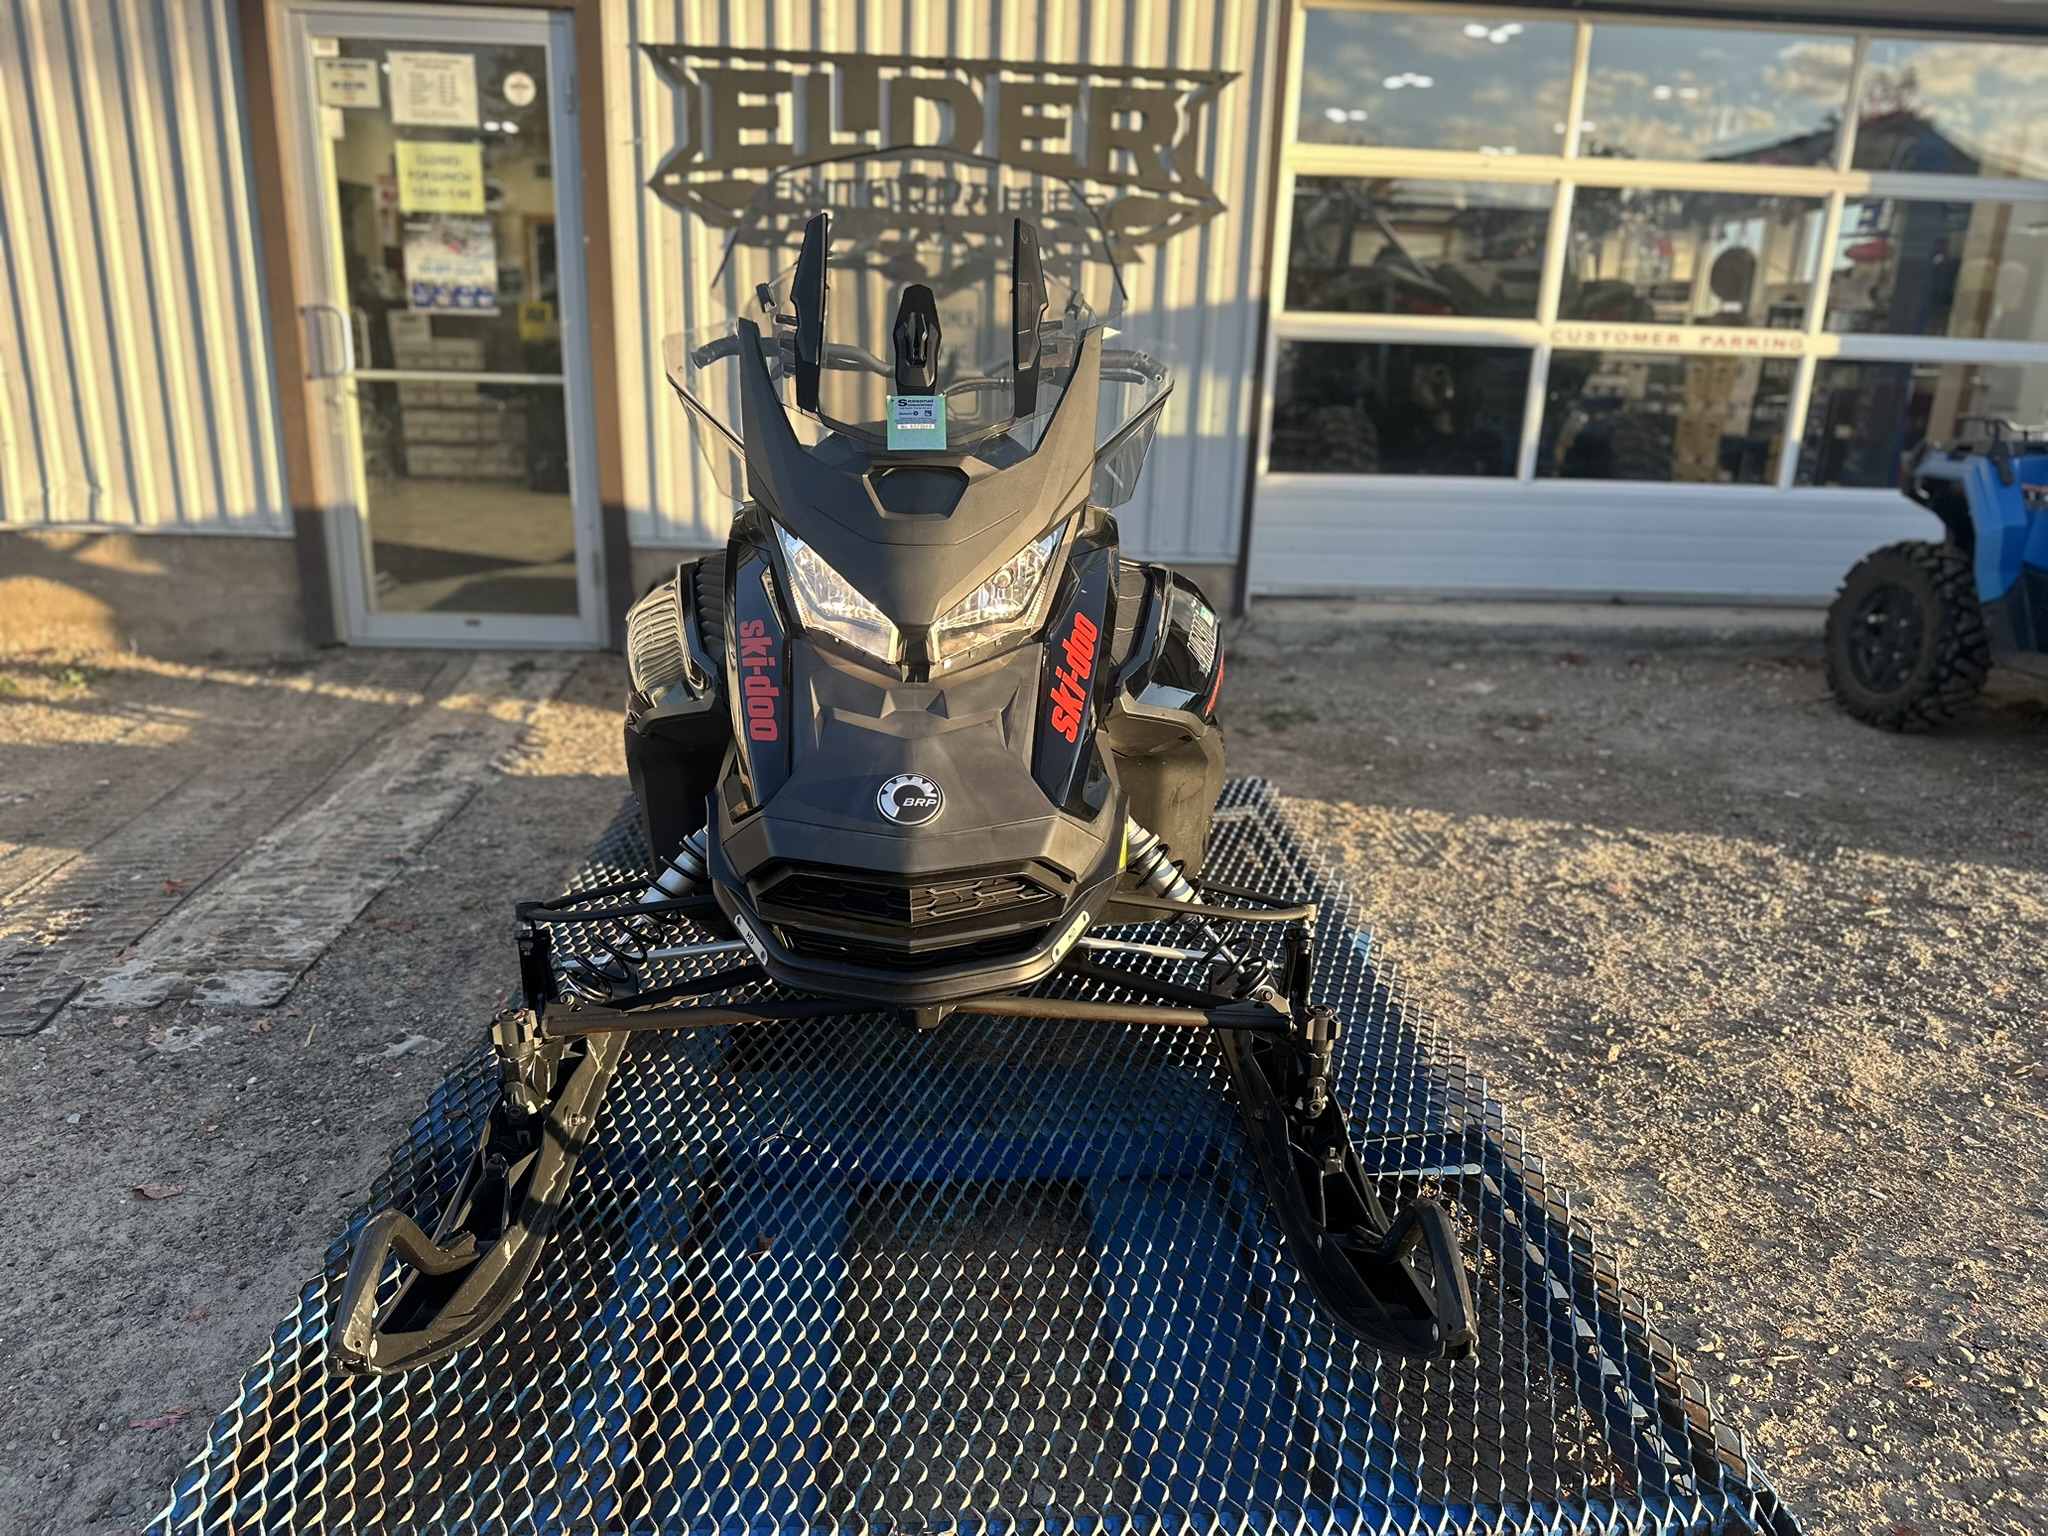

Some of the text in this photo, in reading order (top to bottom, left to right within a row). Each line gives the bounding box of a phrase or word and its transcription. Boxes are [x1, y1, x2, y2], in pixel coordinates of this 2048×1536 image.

[703, 62, 1192, 178] ELDER
[1550, 328, 1805, 351] CUSTOMER PARKING
[739, 619, 779, 742] ski-doo
[1051, 611, 1099, 744] ski-doo
[902, 797, 938, 807] BRP
